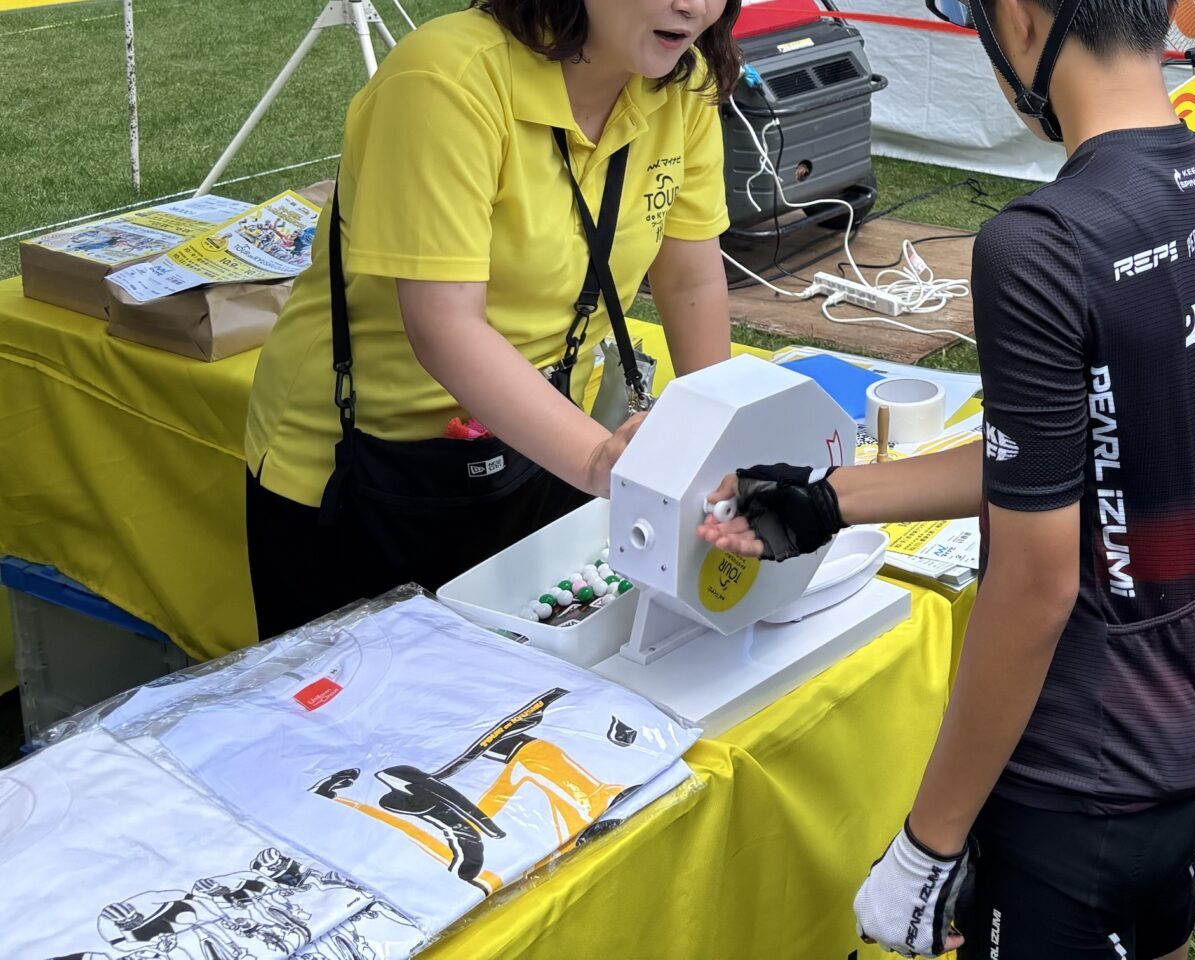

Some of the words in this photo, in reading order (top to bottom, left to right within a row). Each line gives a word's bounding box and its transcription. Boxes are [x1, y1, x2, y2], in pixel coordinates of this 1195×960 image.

[1089, 365, 1121, 482] PEARL
[718, 558, 742, 584] TOUR
[480, 727, 505, 747] TOUR
[905, 905, 925, 952] PEARL
